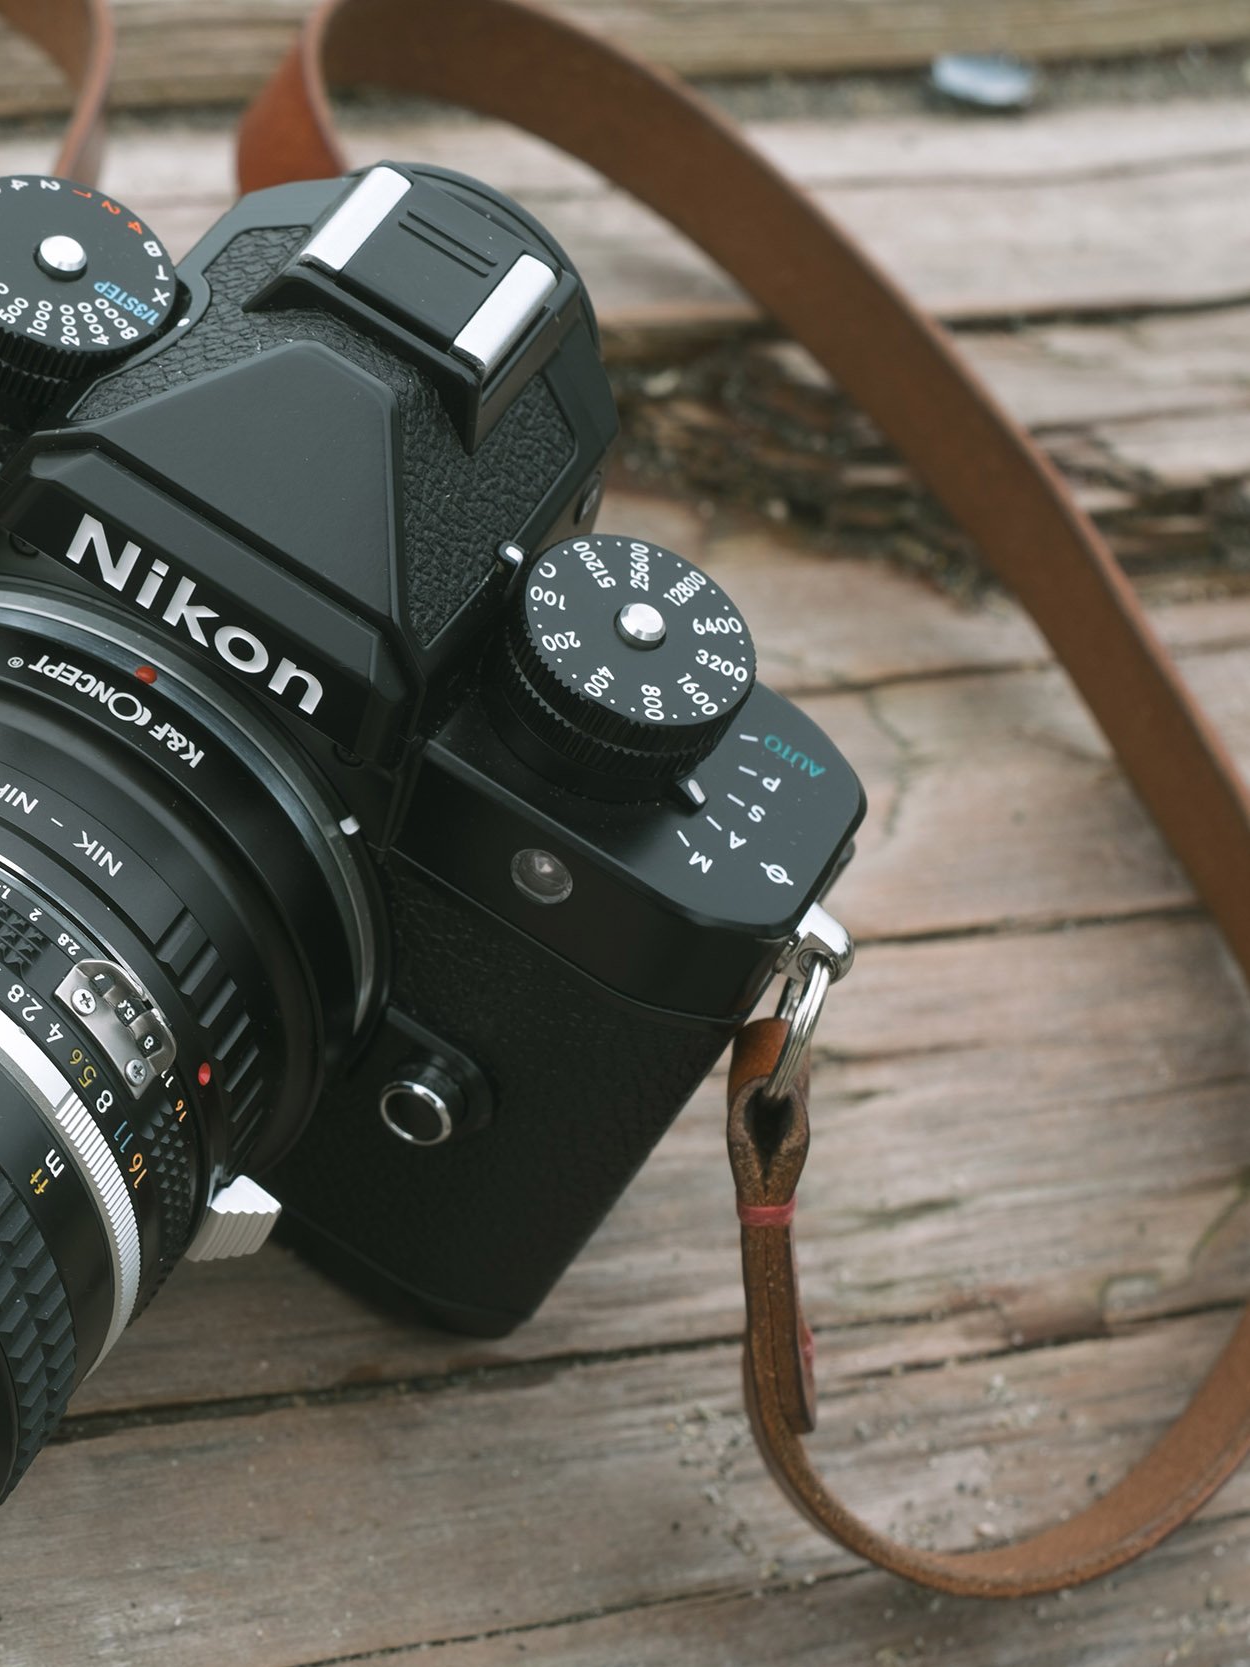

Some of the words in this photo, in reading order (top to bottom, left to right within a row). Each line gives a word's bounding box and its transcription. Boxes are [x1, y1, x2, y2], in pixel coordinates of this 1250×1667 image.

[10, 179, 29, 191] 4
[40, 179, 61, 191] 2
[102, 201, 121, 215] 2
[127, 221, 143, 235] 4
[143, 240, 164, 258] B
[152, 288, 171, 307] X
[26, 300, 53, 337] 1000
[59, 304, 81, 347] 2000
[77, 302, 109, 346] 4000
[95, 298, 139, 340] 8000
[538, 562, 557, 579] C
[572, 541, 617, 589] 51200
[630, 542, 650, 591] 25600
[530, 585, 566, 611] 100
[663, 571, 707, 607] 12800
[65, 512, 325, 717] Nikon
[692, 617, 743, 636] 6400
[541, 631, 581, 652] 200
[695, 649, 748, 683] 3200
[583, 665, 615, 698] 400
[676, 672, 718, 716] 1600
[640, 684, 665, 721] 800
[148, 722, 205, 769] K&F
[764, 734, 827, 778] AUTO
[762, 777, 781, 792] P
[747, 805, 766, 823] S
[72, 830, 123, 877] NIK
[729, 831, 747, 850] A
[688, 851, 713, 874] M
[29, 908, 43, 922] 2
[57, 933, 81, 956] 2.8
[7, 984, 44, 1022] 2.8
[46, 1022, 64, 1043] 4
[69, 1049, 98, 1089] 5.6
[96, 1089, 114, 1114] 8
[114, 1120, 134, 1153] 11
[45, 1148, 65, 1178] m
[129, 1152, 147, 1189] 16
[29, 1168, 49, 1195] ft
